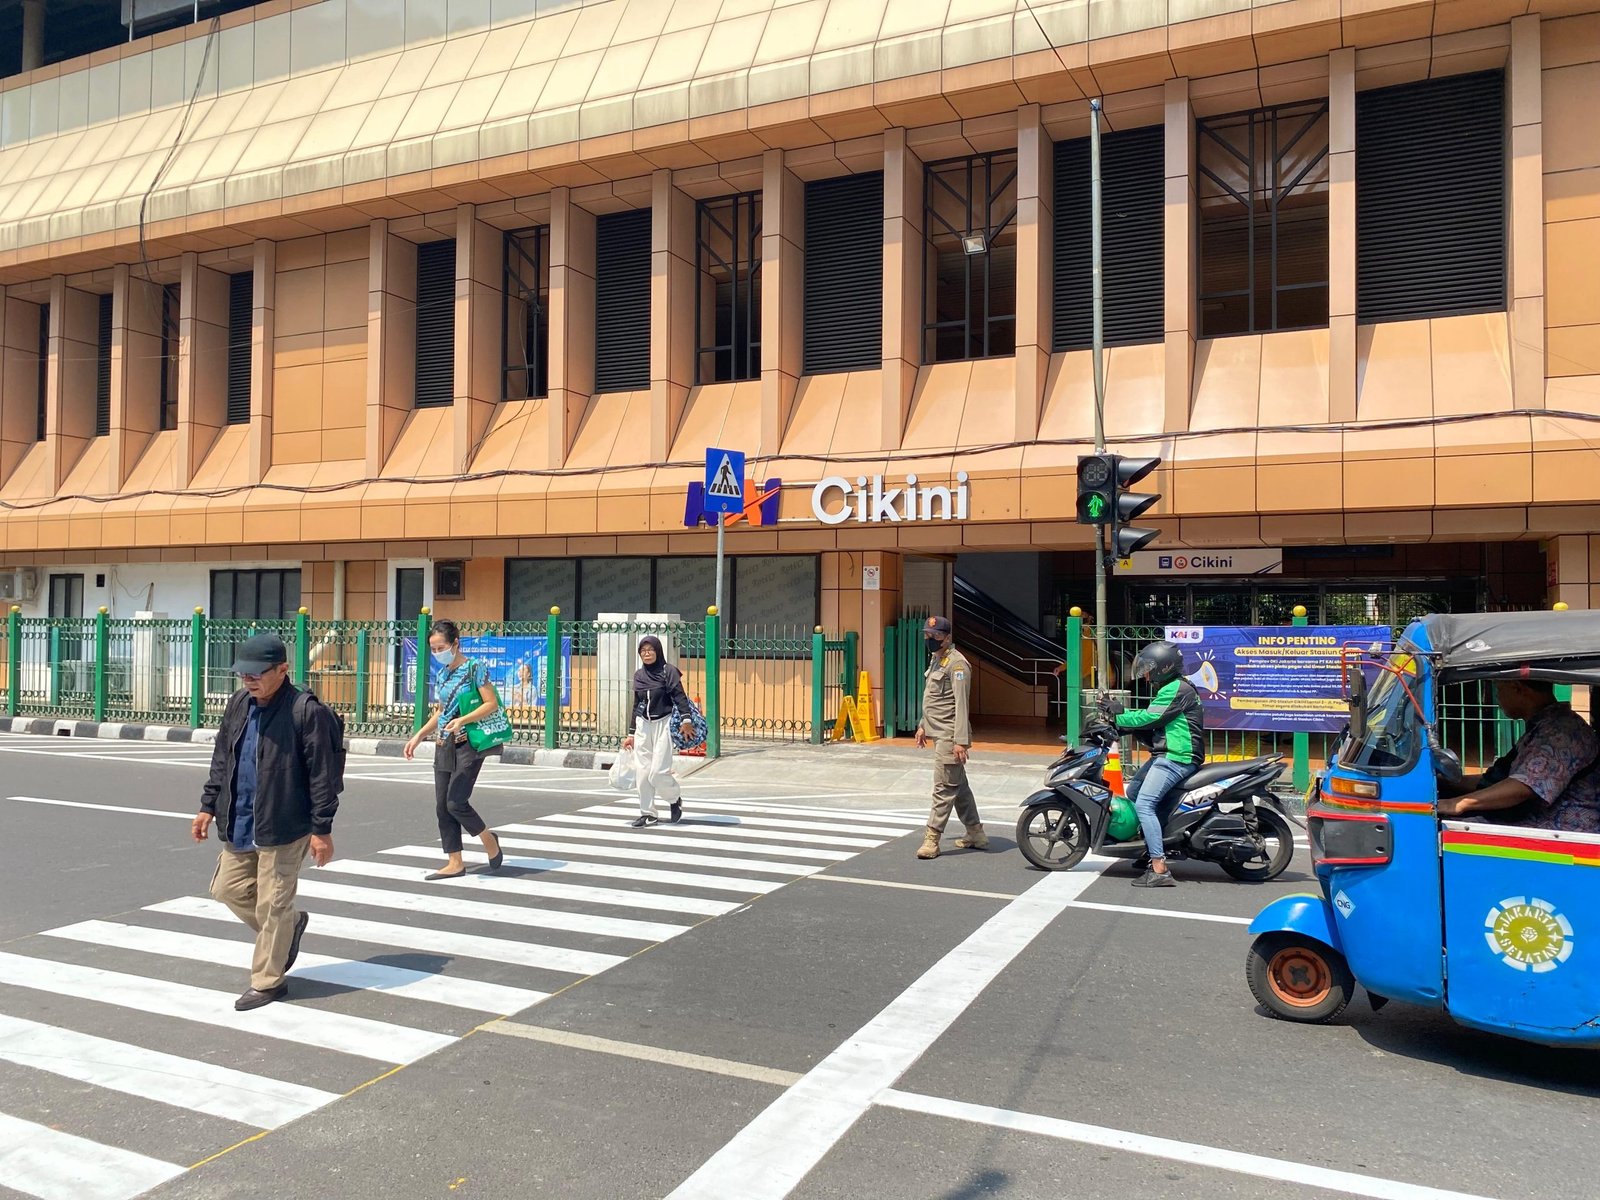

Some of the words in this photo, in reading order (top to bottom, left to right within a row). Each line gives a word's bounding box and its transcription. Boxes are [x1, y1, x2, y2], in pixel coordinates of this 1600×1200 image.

[812, 471, 969, 525] Cikini
[1190, 556, 1233, 568] Cikini
[1258, 636, 1285, 645] INFO
[1286, 636, 1336, 646] PENTING
[1336, 899, 1351, 910] CNG
[1500, 906, 1558, 932] JAKARTA
[1500, 938, 1559, 963] SELATAN
